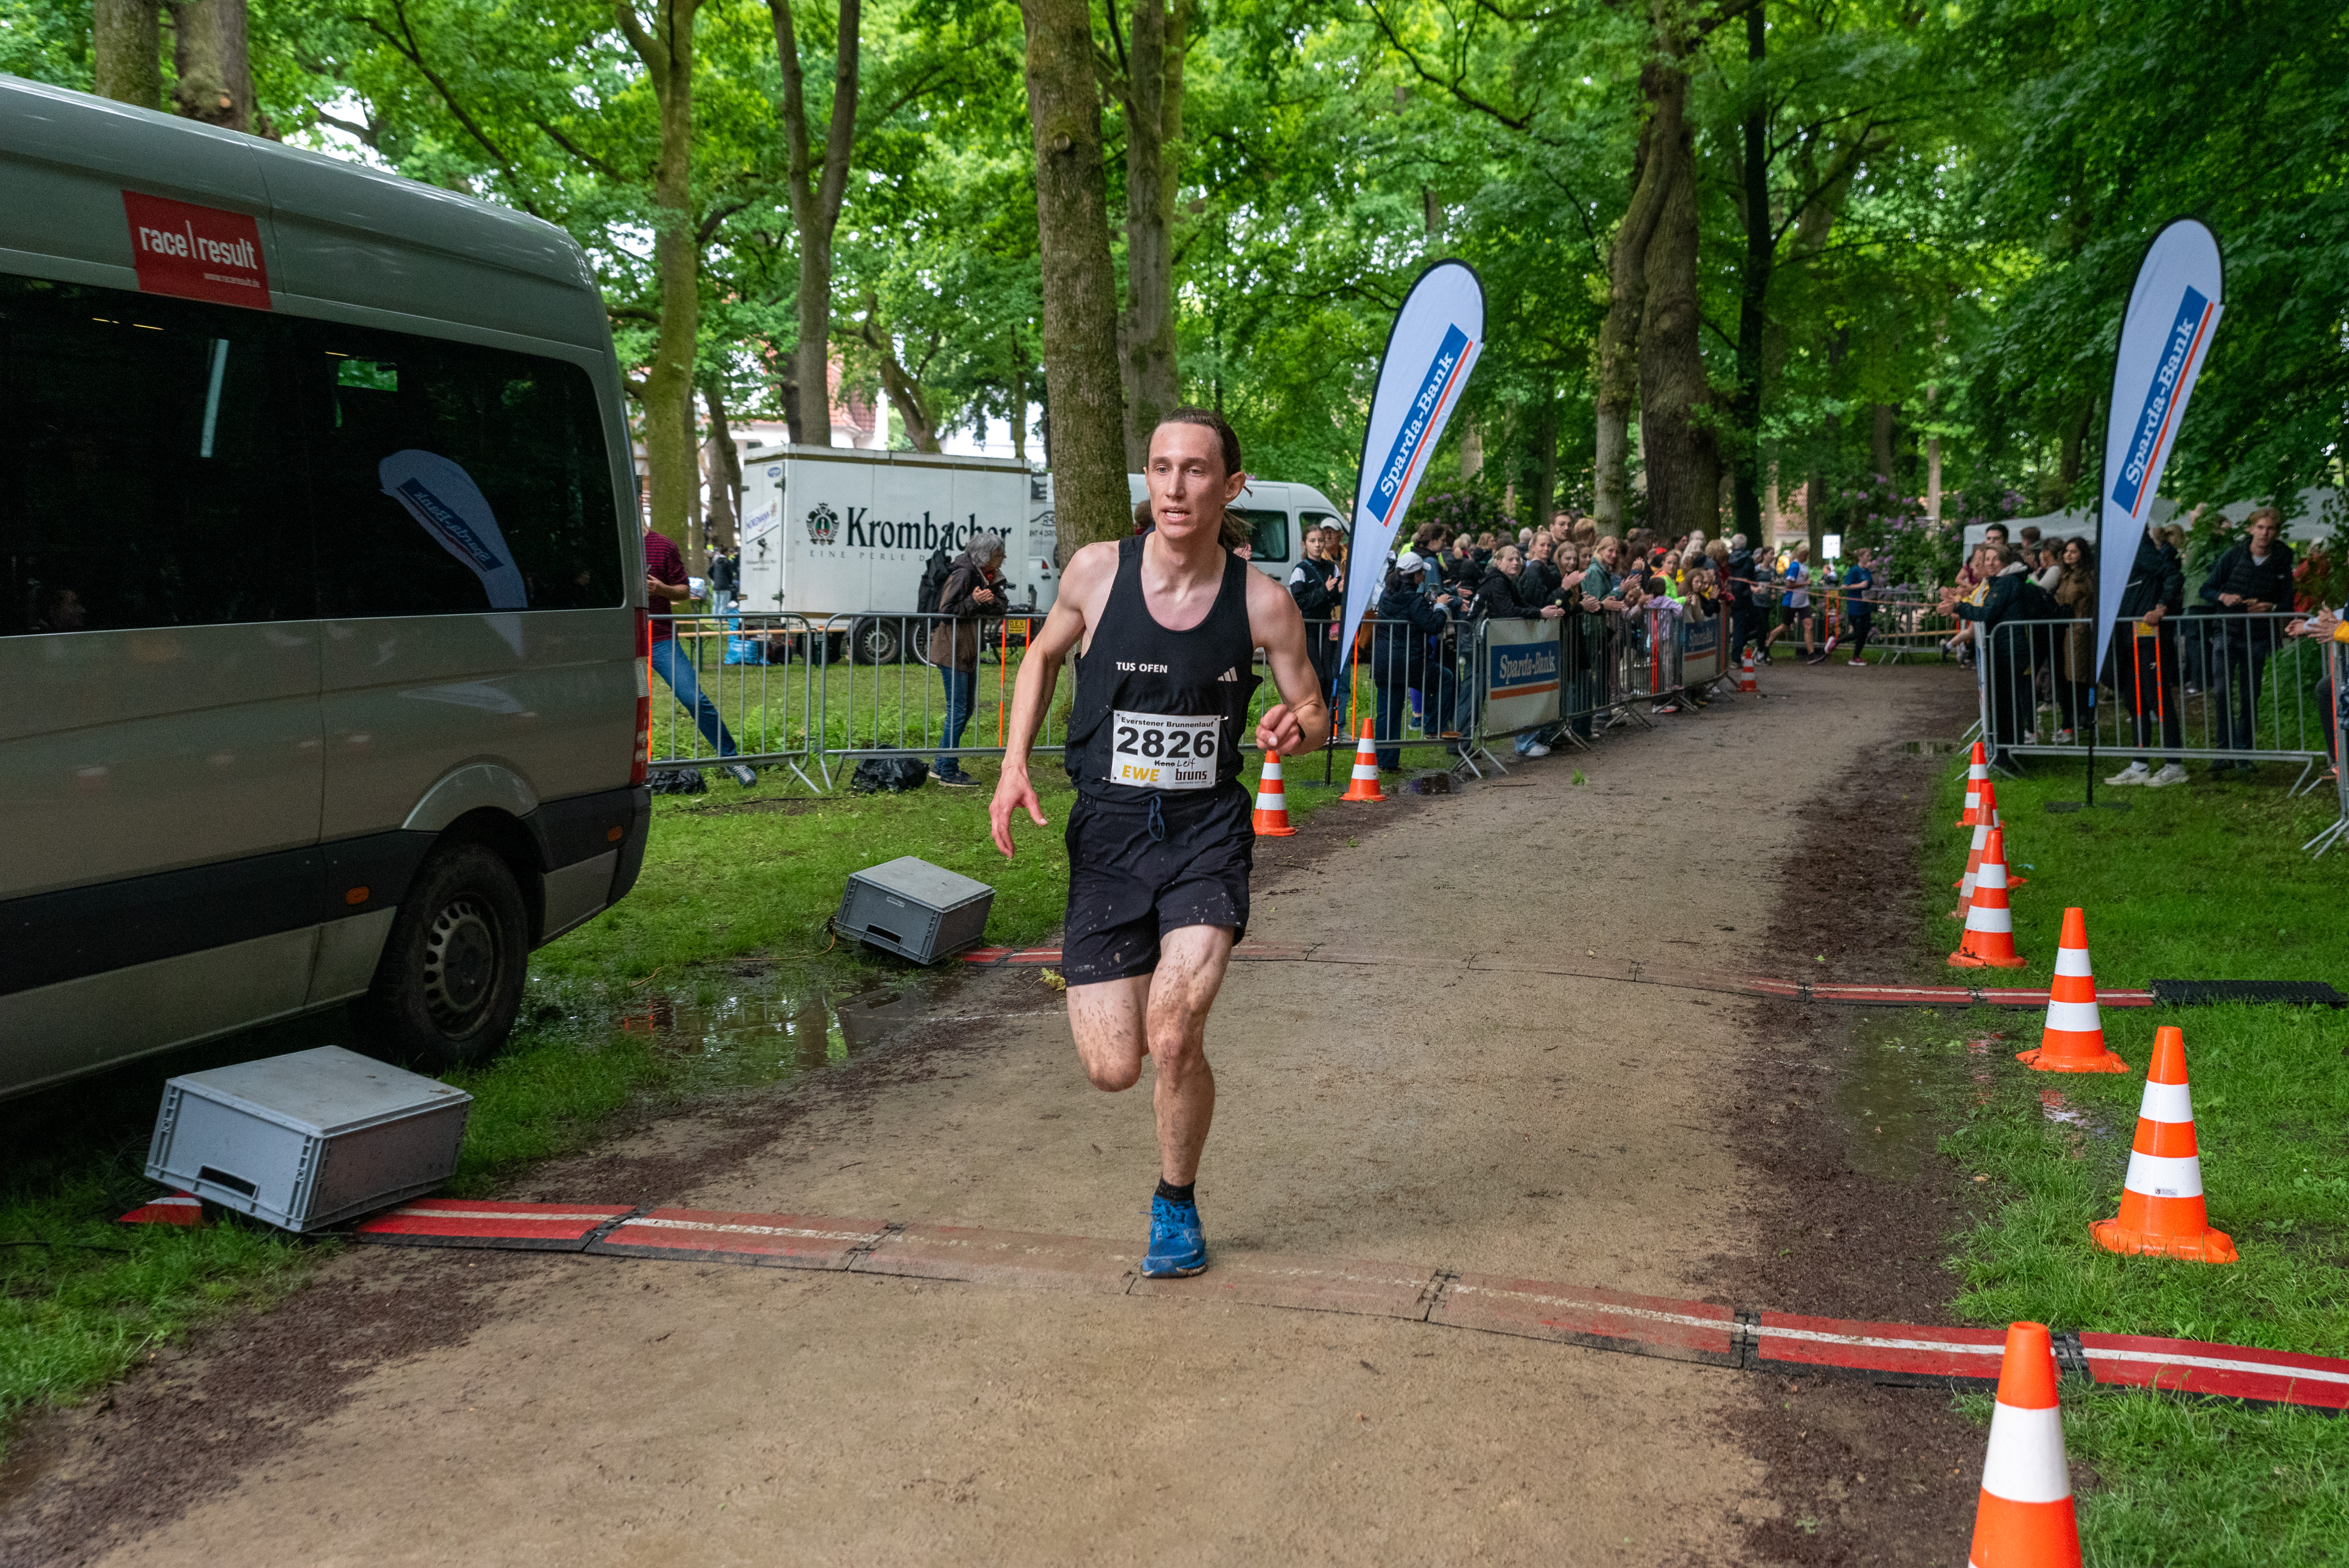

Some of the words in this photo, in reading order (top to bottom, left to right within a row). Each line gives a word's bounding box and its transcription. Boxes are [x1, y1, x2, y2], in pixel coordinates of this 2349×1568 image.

[2125, 317, 2194, 486] Sparda-Bank
[1380, 352, 1454, 497] Sparda-Bank
[810, 550, 845, 559] EINE
[859, 552, 906, 561] PERLE
[1116, 661, 1136, 672] TUS
[1138, 663, 1168, 673] OFEN
[1500, 650, 1556, 685] Sparda-Bank
[1121, 717, 1164, 727] Everstener
[1116, 726, 1216, 758] 2826
[1177, 758, 1196, 769] Leif
[1122, 765, 1160, 782] EWE
[1175, 768, 1207, 781] bruns
